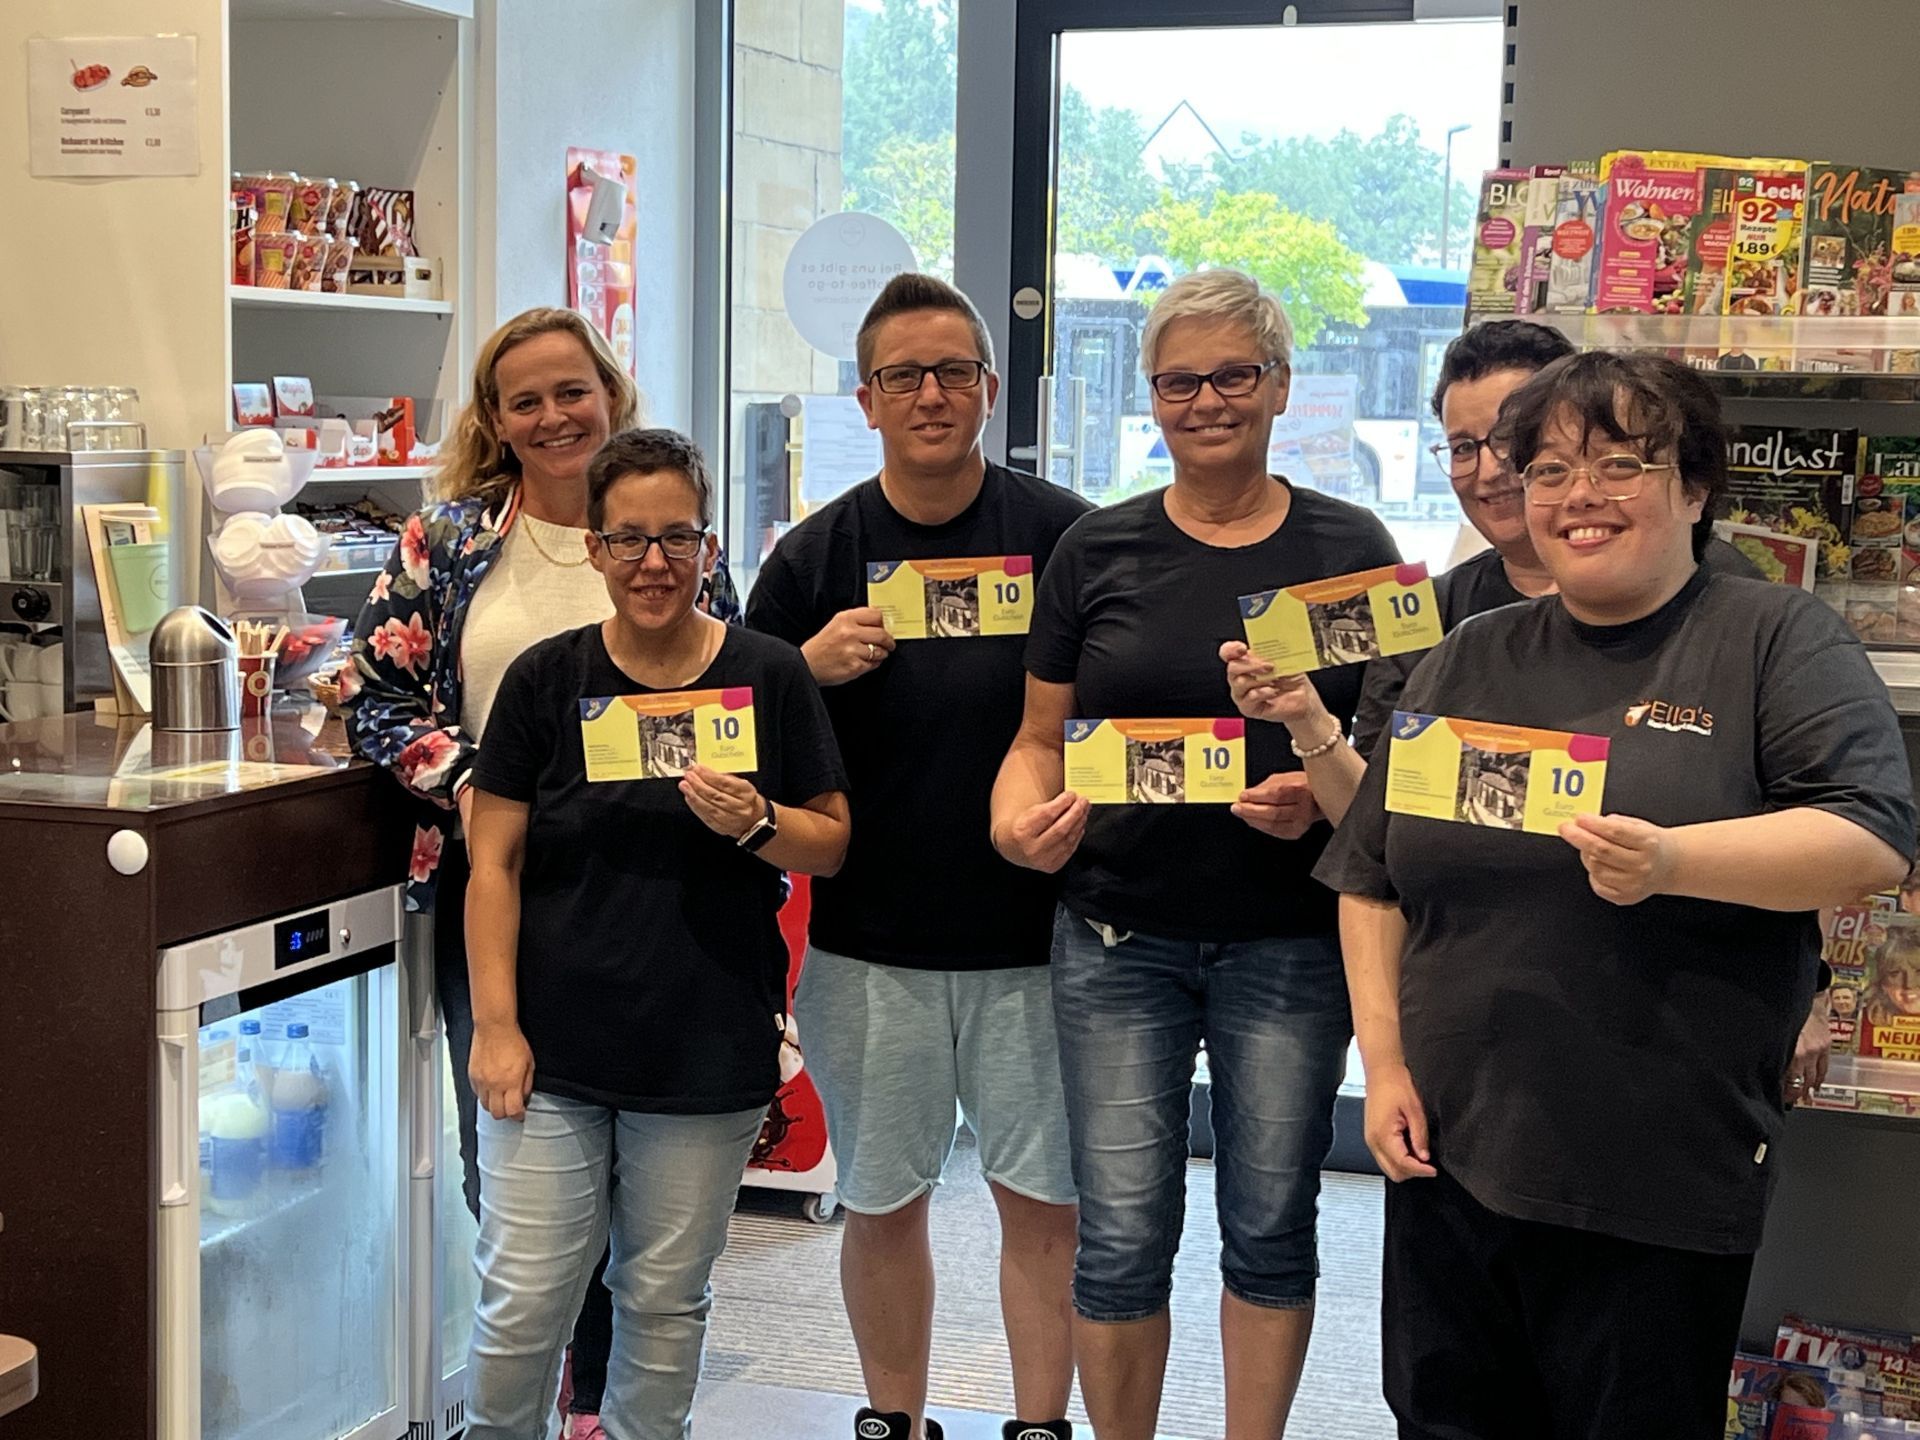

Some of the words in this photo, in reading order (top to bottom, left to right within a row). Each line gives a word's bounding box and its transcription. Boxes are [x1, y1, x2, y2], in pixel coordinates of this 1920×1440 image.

[1615, 178, 1695, 202] Wohnen
[1755, 181, 1804, 200] Leck
[1742, 201, 1778, 223] 92
[1740, 224, 1777, 233] Rezepte
[994, 582, 1020, 603] 10
[1388, 591, 1420, 619] 10
[1651, 700, 1714, 728] Ella's
[712, 717, 740, 741] 10
[1202, 747, 1230, 770] 10
[1552, 768, 1585, 797] 10
[1782, 1331, 1841, 1368] TV
[1884, 1355, 1905, 1373] 14
